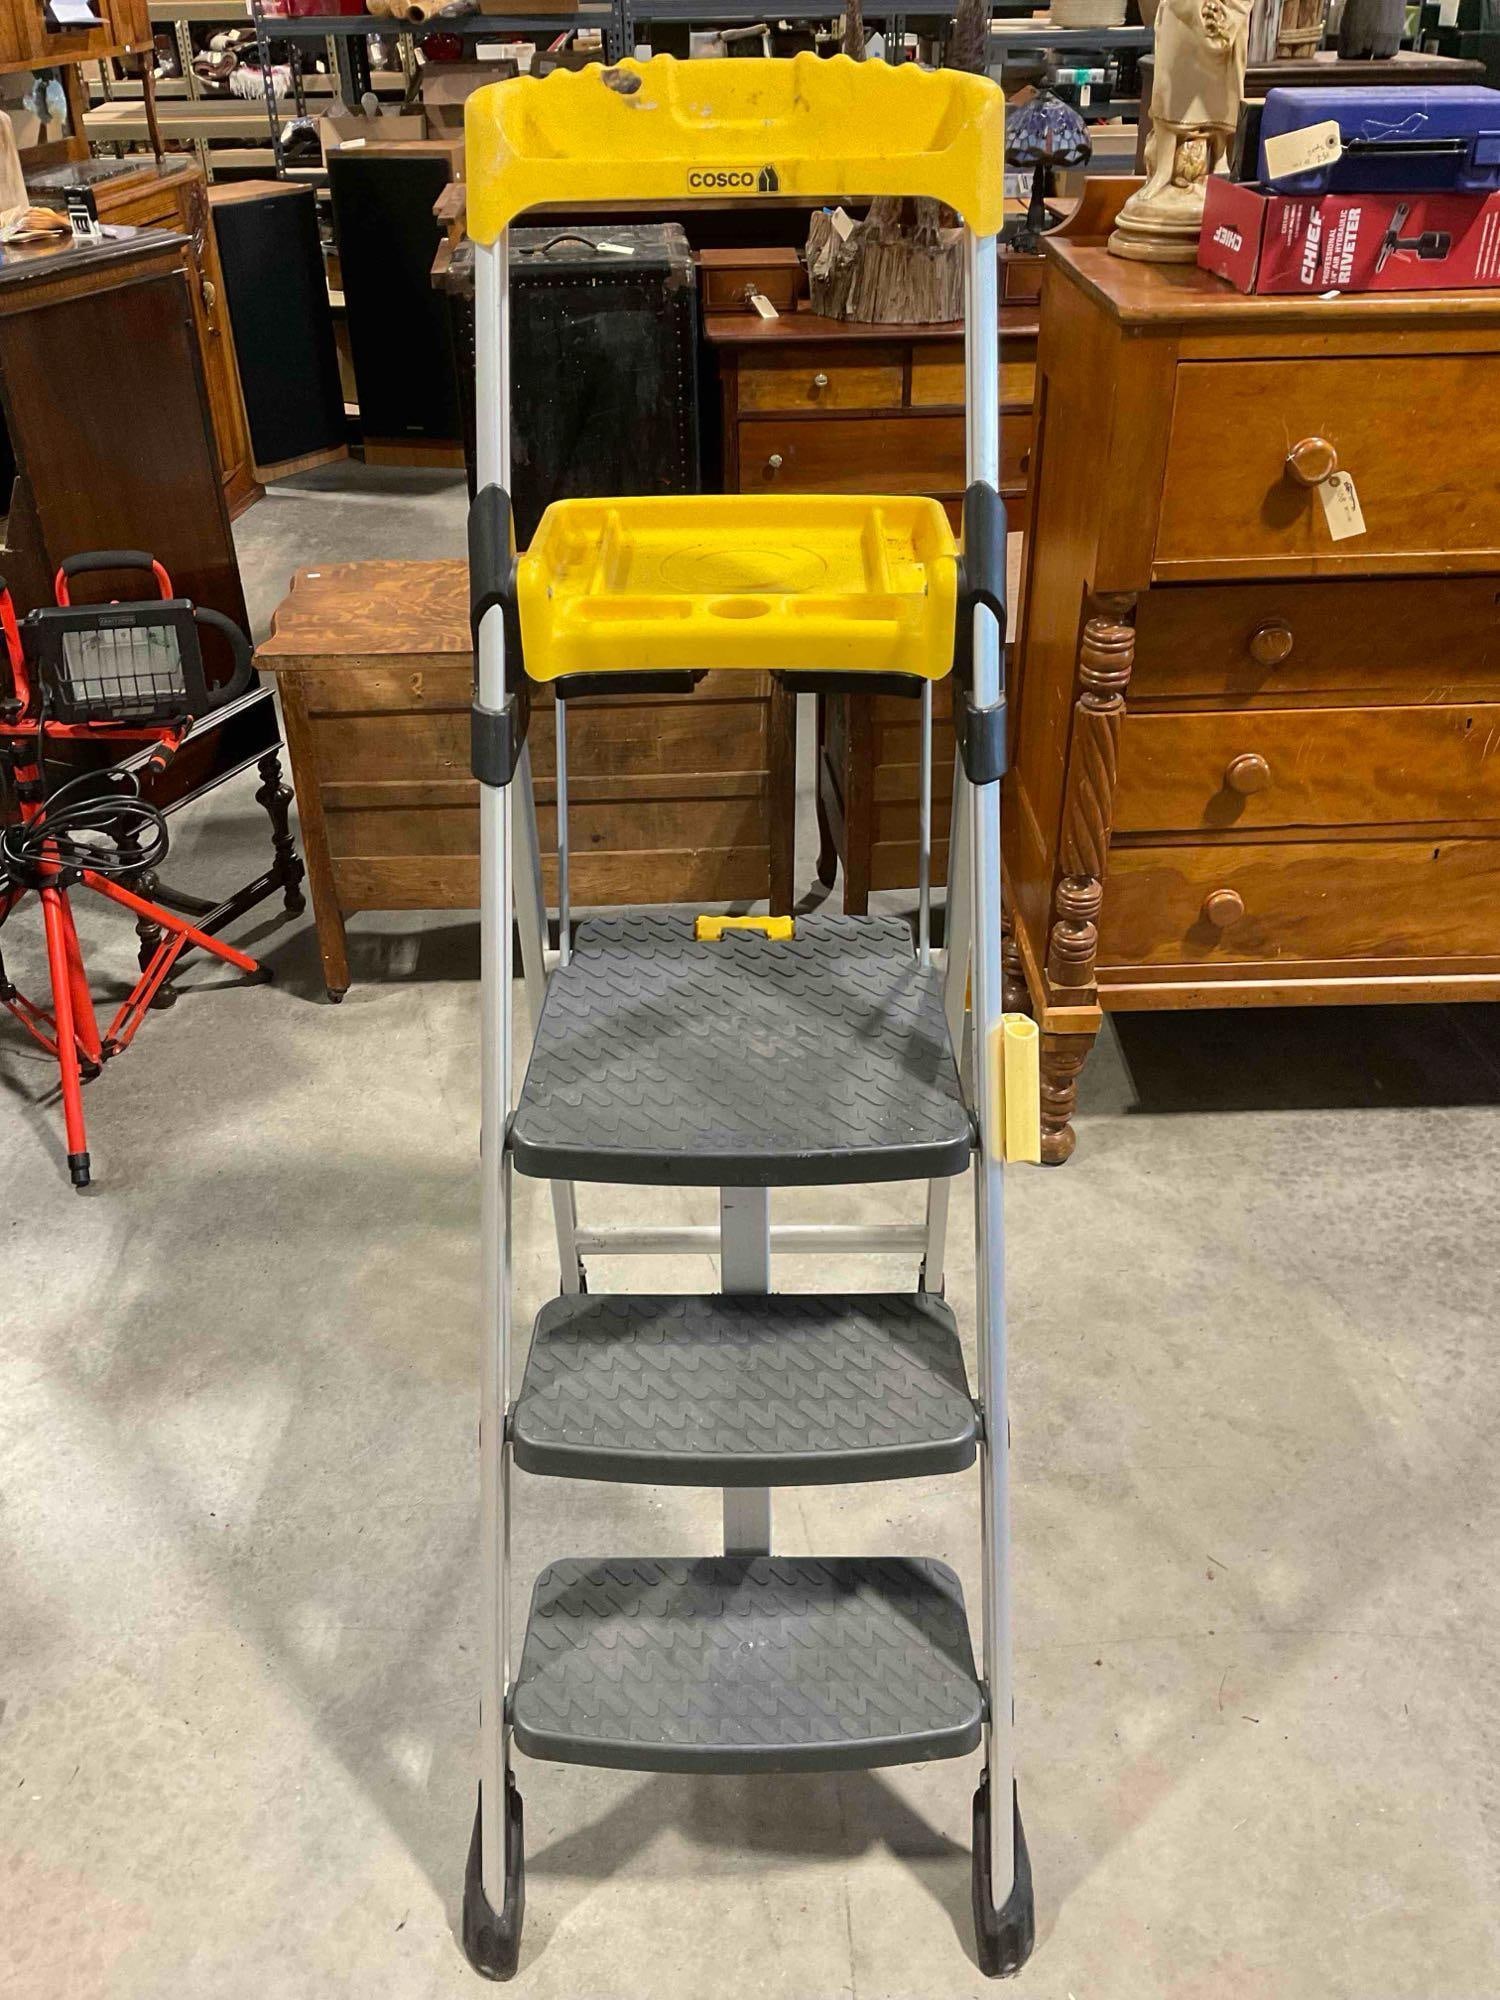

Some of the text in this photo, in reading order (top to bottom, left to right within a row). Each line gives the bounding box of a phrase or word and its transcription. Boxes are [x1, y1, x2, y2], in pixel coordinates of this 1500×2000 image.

[689, 172, 754, 187] COSCO
[1213, 226, 1242, 252] CHIEF
[1301, 205, 1322, 285] CHIEF
[1335, 209, 1348, 253] HYDRAULIC
[1338, 207, 1361, 284] RIVETER
[1322, 228, 1336, 285] PROFESSIONAL
[1332, 255, 1341, 270] AIR
